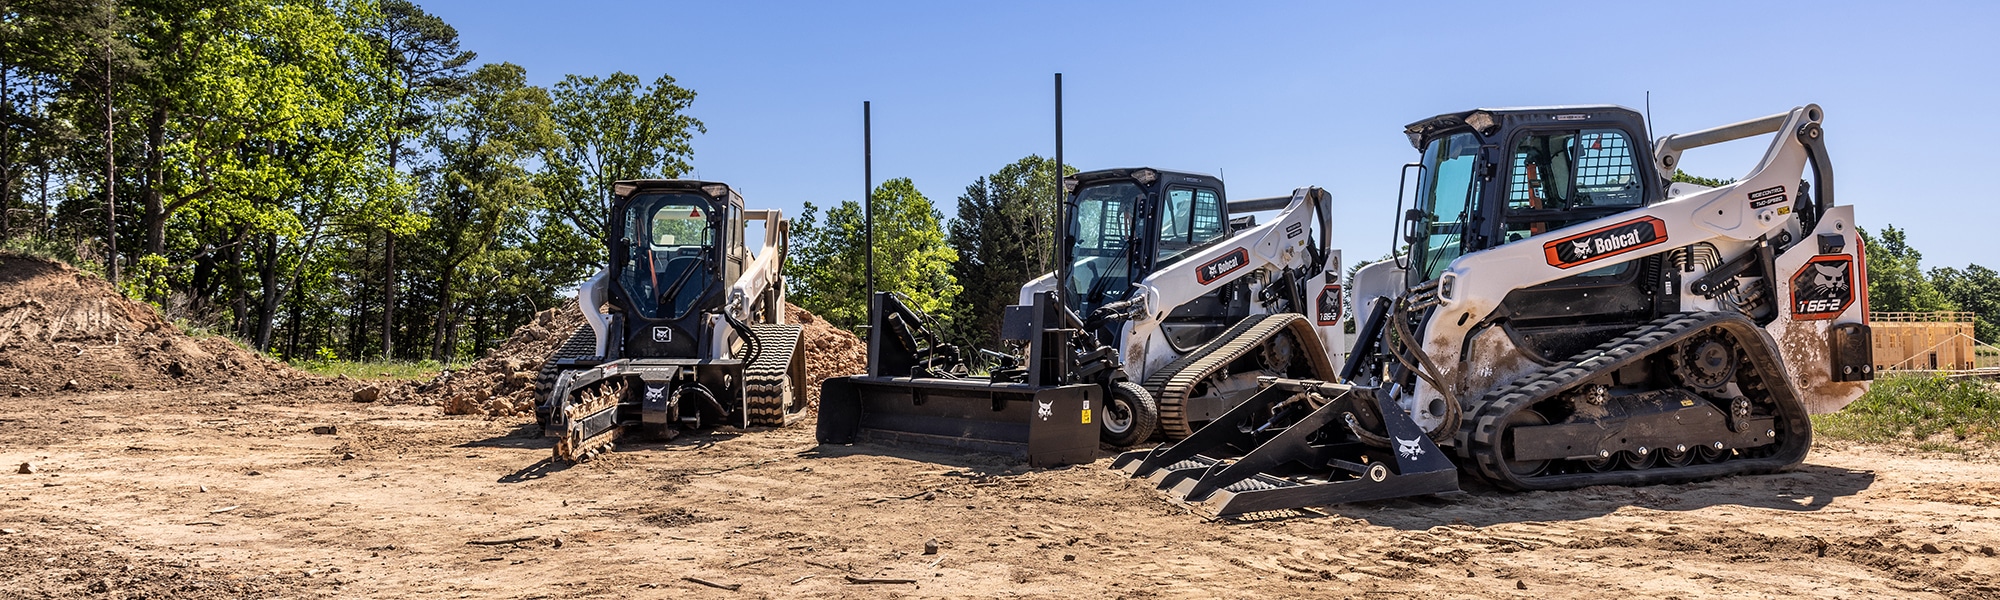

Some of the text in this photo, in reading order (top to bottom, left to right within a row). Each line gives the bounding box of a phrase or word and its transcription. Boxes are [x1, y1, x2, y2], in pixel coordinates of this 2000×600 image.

[1594, 229, 1641, 254] Bobcat
[1217, 256, 1238, 274] Bobcat
[1799, 298, 1841, 313] T66-2
